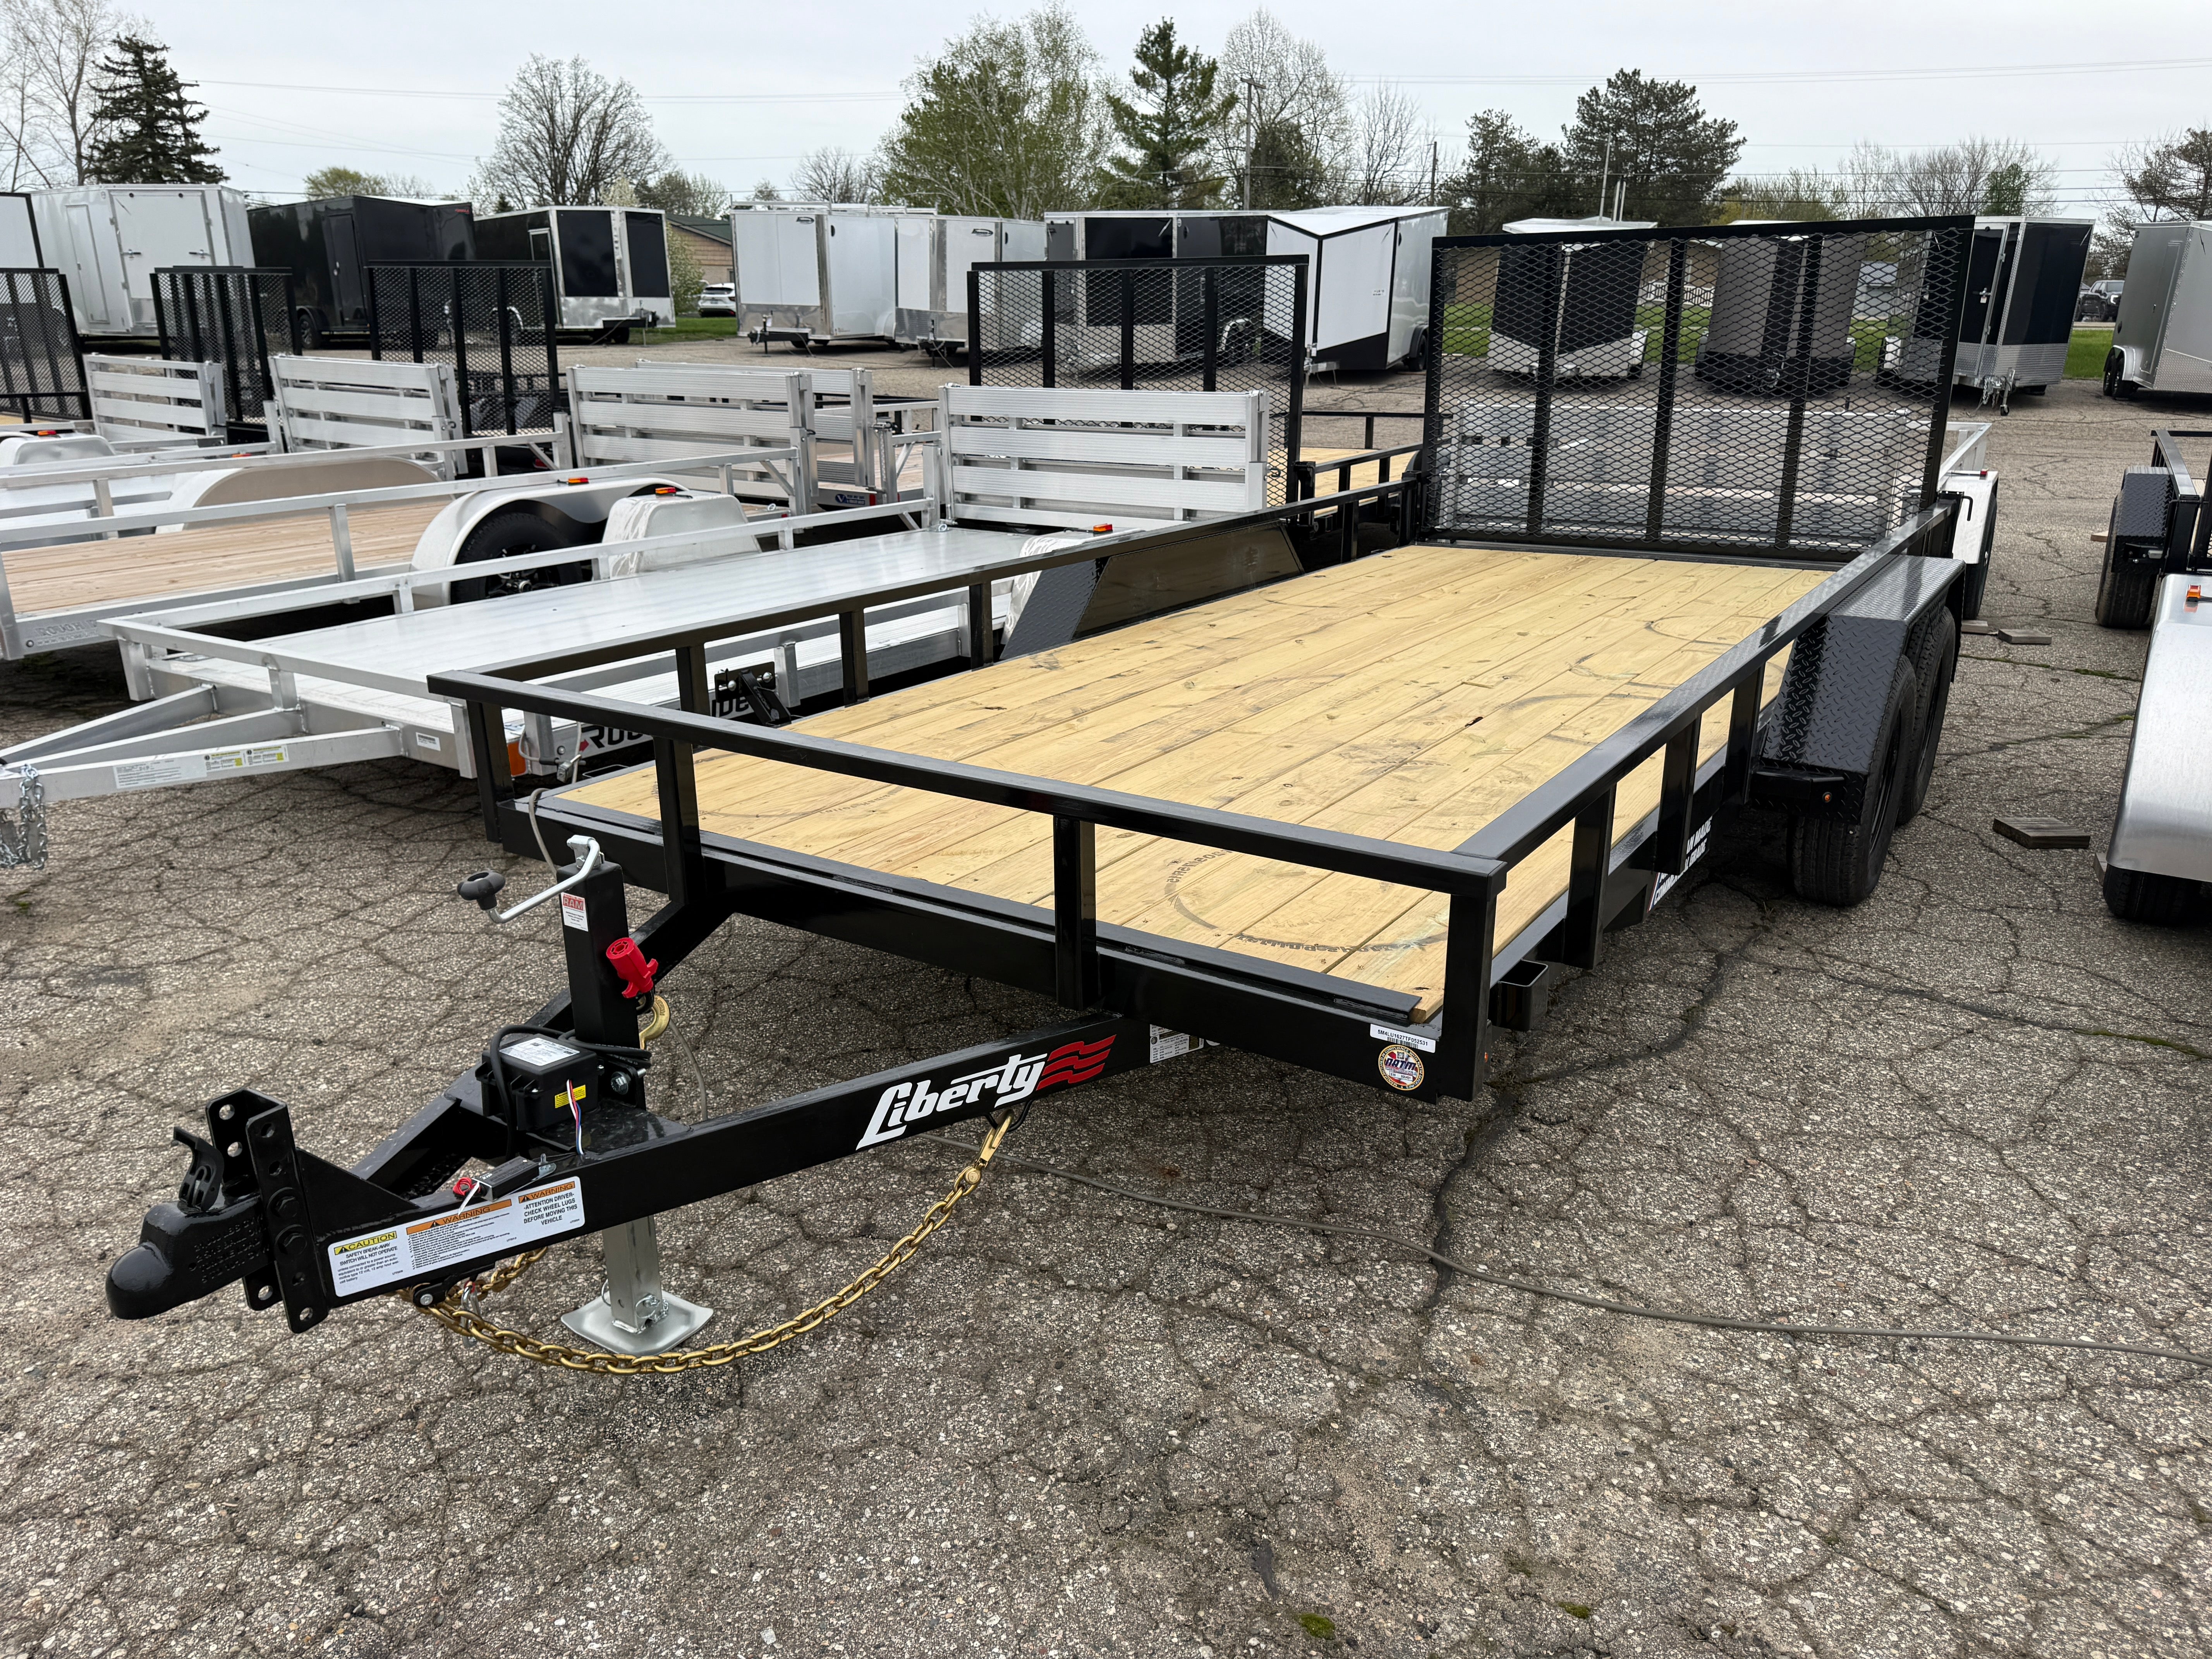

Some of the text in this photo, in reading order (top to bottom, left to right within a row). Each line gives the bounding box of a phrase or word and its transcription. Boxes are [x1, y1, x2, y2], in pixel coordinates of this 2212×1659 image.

[1694, 816, 1712, 847] MADE
[1689, 838, 1707, 867] GRADE
[563, 897, 584, 910] RAM
[855, 1053, 1048, 1151] Liberty
[531, 1183, 573, 1199] WARNING
[443, 1207, 490, 1224] WARNING
[524, 1207, 542, 1217] CHECK
[543, 1203, 561, 1211] WHEEL
[524, 1214, 544, 1224] BEFORE
[546, 1207, 565, 1218] MOVING
[541, 1215, 563, 1225] VEHICLE
[349, 1233, 395, 1250] CAUTION
[346, 1242, 390, 1259] SAFETY BREAK-AWAY
[378, 1246, 398, 1255] OPERATE
